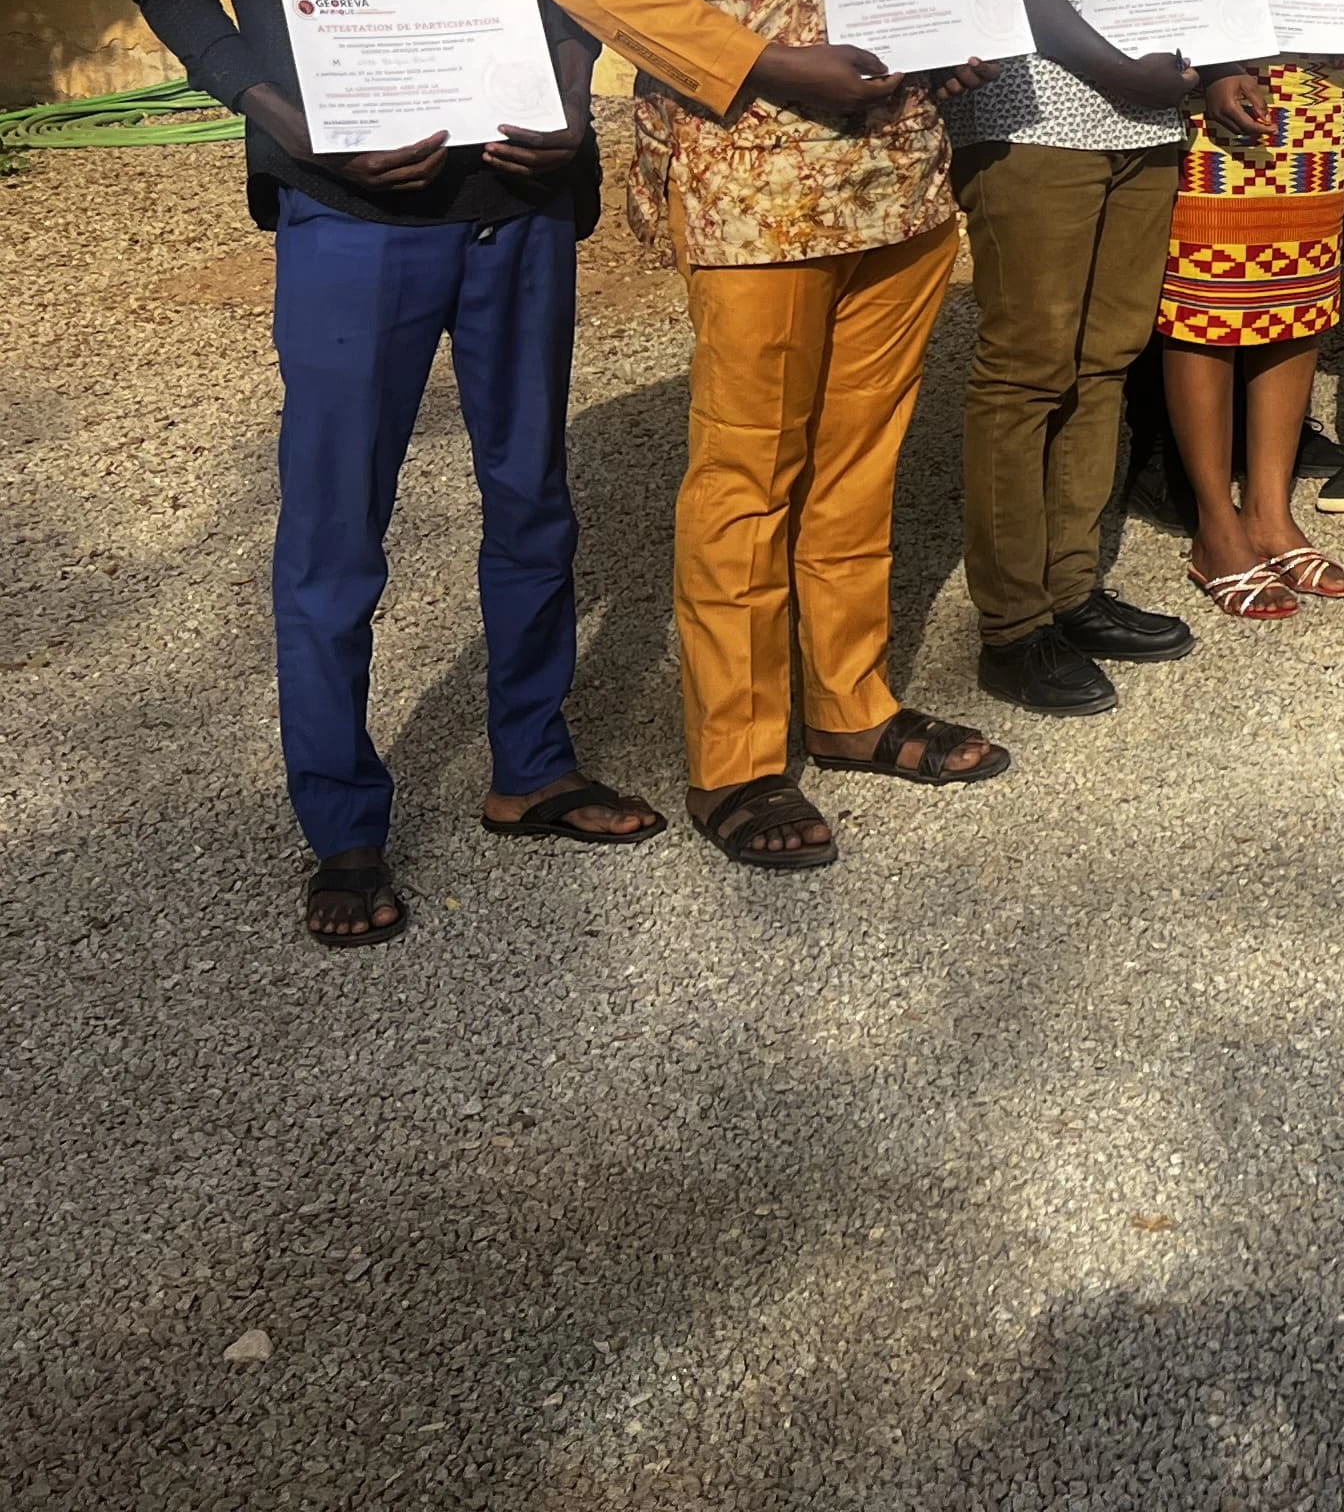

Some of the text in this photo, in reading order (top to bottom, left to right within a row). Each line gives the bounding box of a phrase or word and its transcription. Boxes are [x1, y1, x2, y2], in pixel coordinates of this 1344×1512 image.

[317, 16, 501, 33] ATTESTATION DE PARTICIPATION
